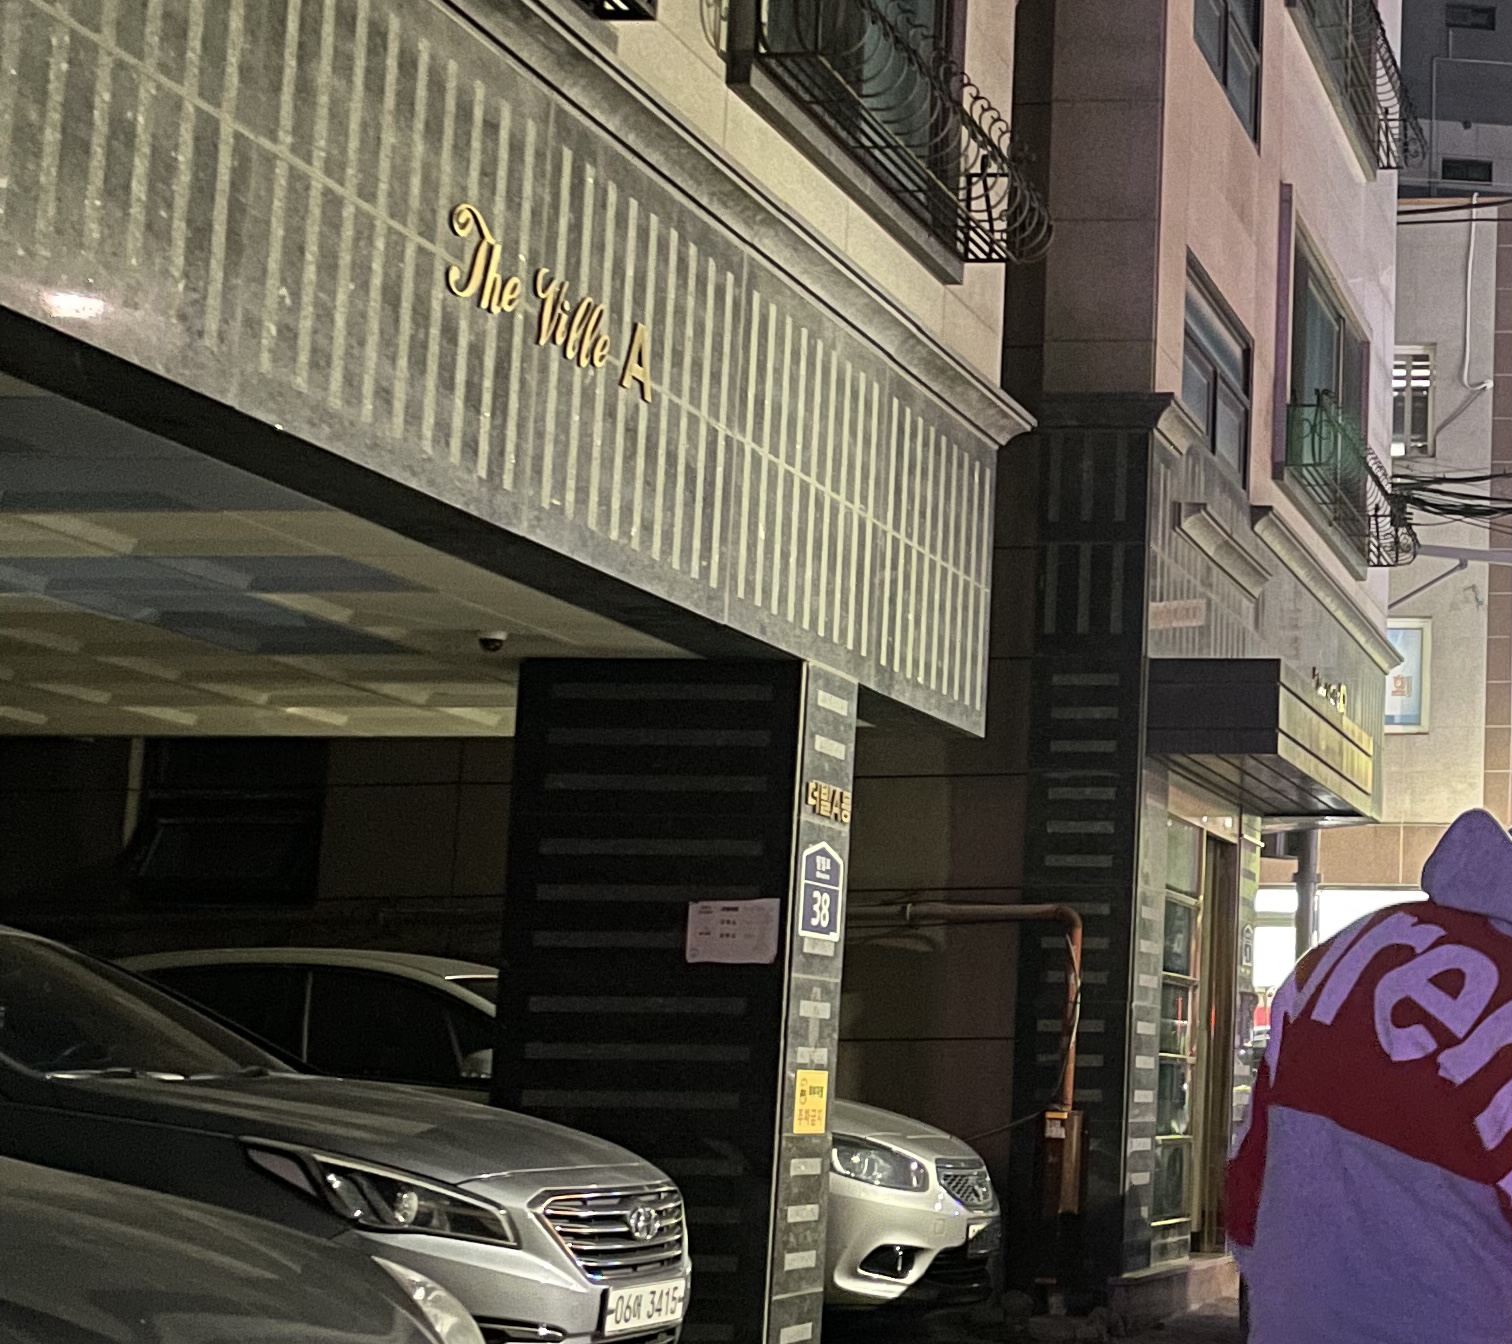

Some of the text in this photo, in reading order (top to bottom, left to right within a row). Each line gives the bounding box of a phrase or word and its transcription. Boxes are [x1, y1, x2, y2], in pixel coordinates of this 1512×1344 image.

[448, 203, 652, 403] The Ville A
[811, 890, 831, 928] 38
[646, 1286, 679, 1319] 3415
